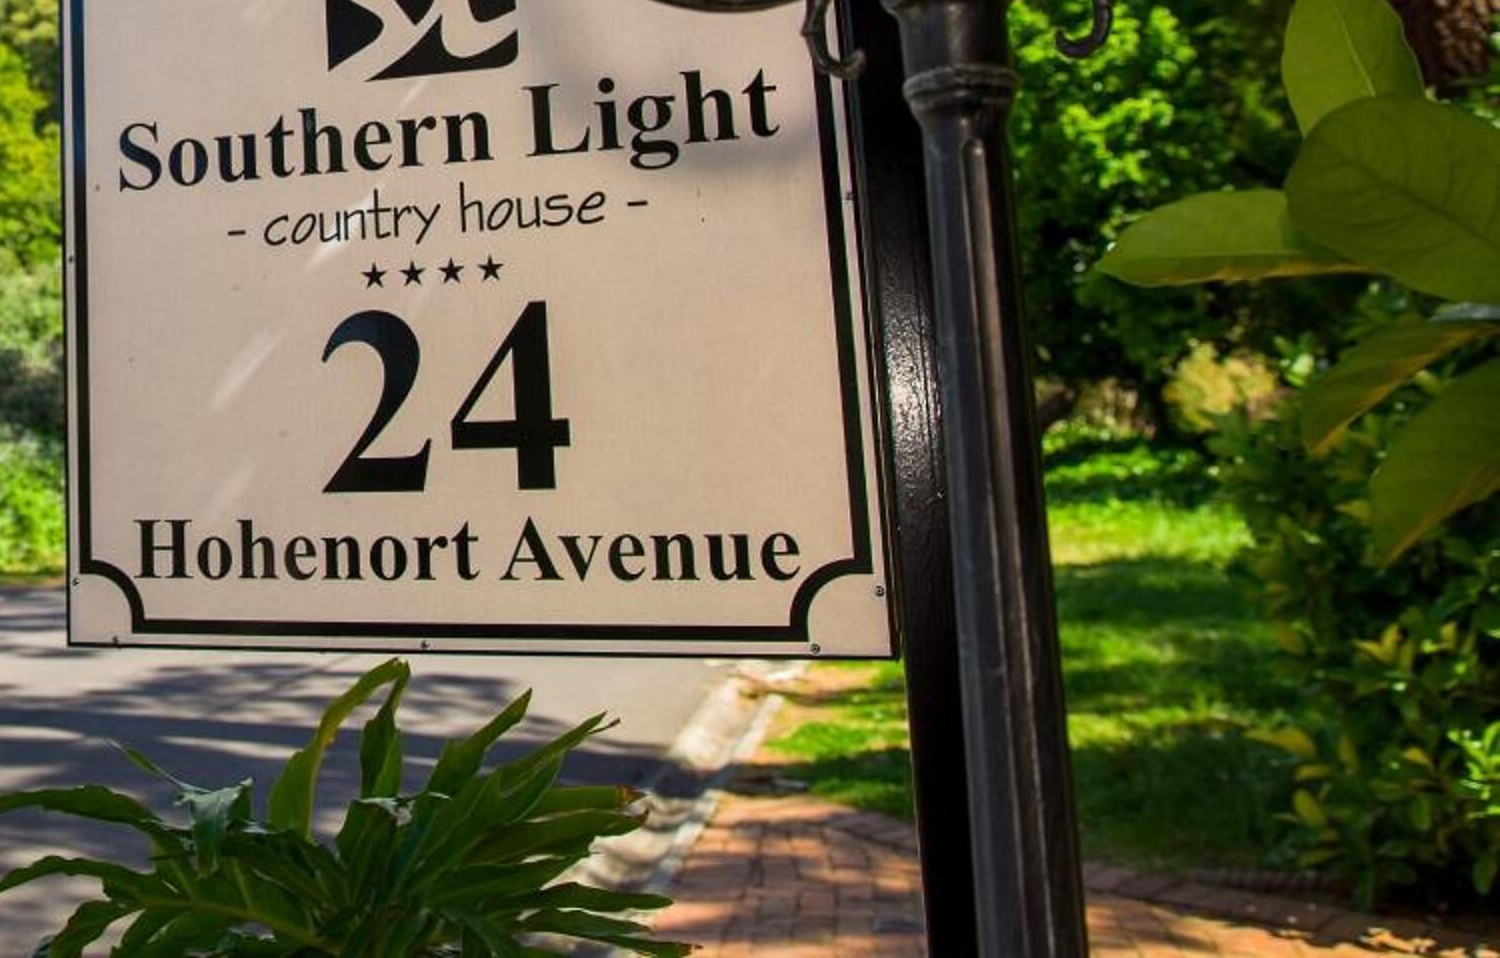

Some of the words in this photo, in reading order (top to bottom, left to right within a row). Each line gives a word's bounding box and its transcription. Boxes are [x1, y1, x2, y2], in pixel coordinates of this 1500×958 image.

[118, 107, 494, 192] Southern
[522, 68, 781, 171] Light
[263, 188, 442, 246] country
[458, 181, 607, 233] house
[321, 300, 571, 494] 24
[133, 518, 480, 582] Hohenort
[499, 516, 802, 582] Avenue
